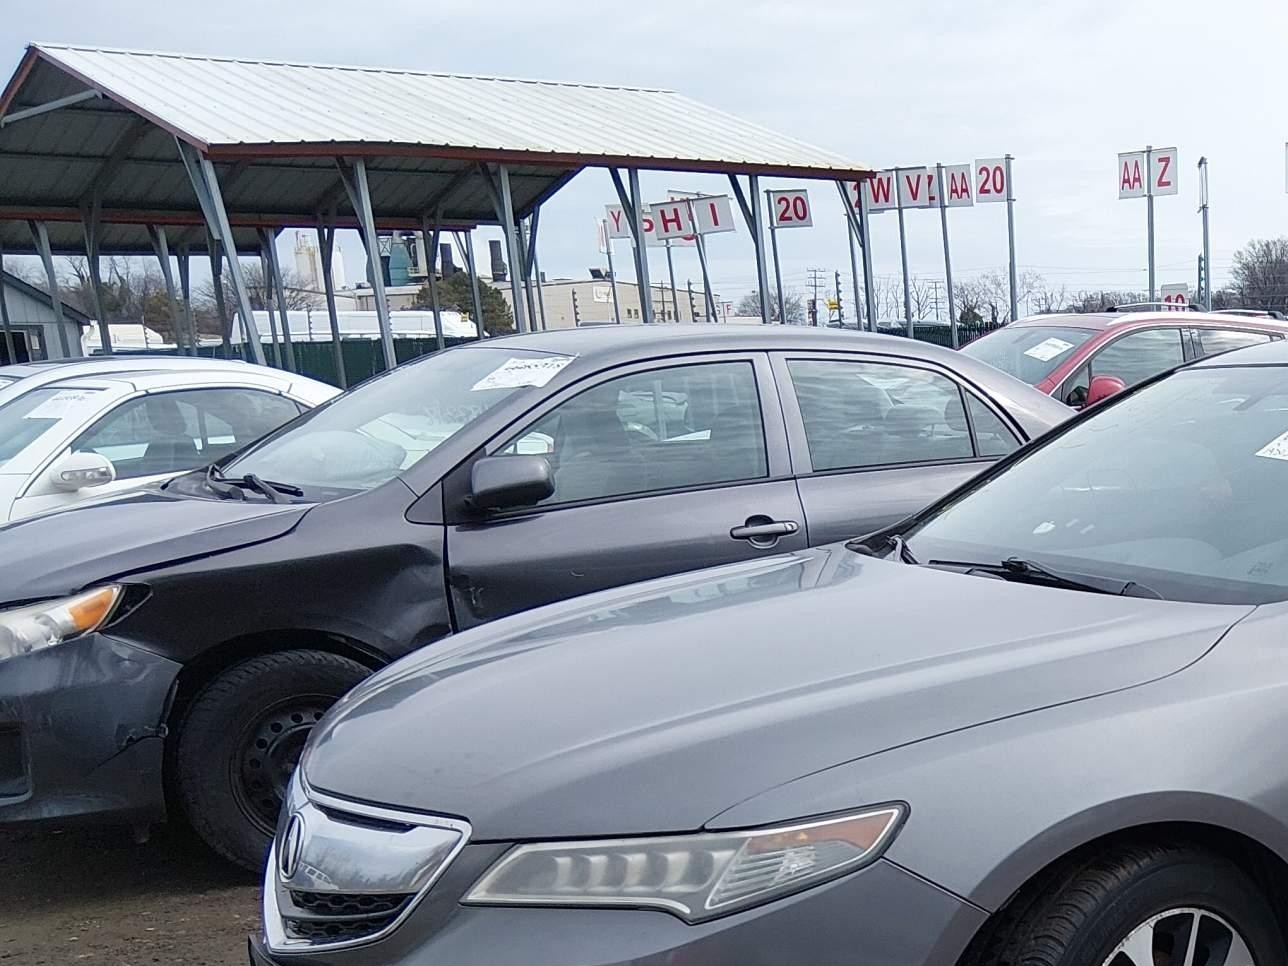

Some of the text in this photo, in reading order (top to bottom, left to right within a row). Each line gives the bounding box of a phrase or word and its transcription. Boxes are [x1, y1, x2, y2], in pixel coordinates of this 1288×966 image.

[978, 166, 1005, 195] 20
[1121, 161, 1142, 190] AA
[1156, 156, 1171, 187] Z
[868, 176, 891, 203] W
[906, 174, 921, 201] V
[950, 172, 970, 200] AA
[610, 211, 622, 233] Y
[660, 208, 683, 233] H
[709, 203, 719, 227] I
[777, 195, 808, 222] 20
